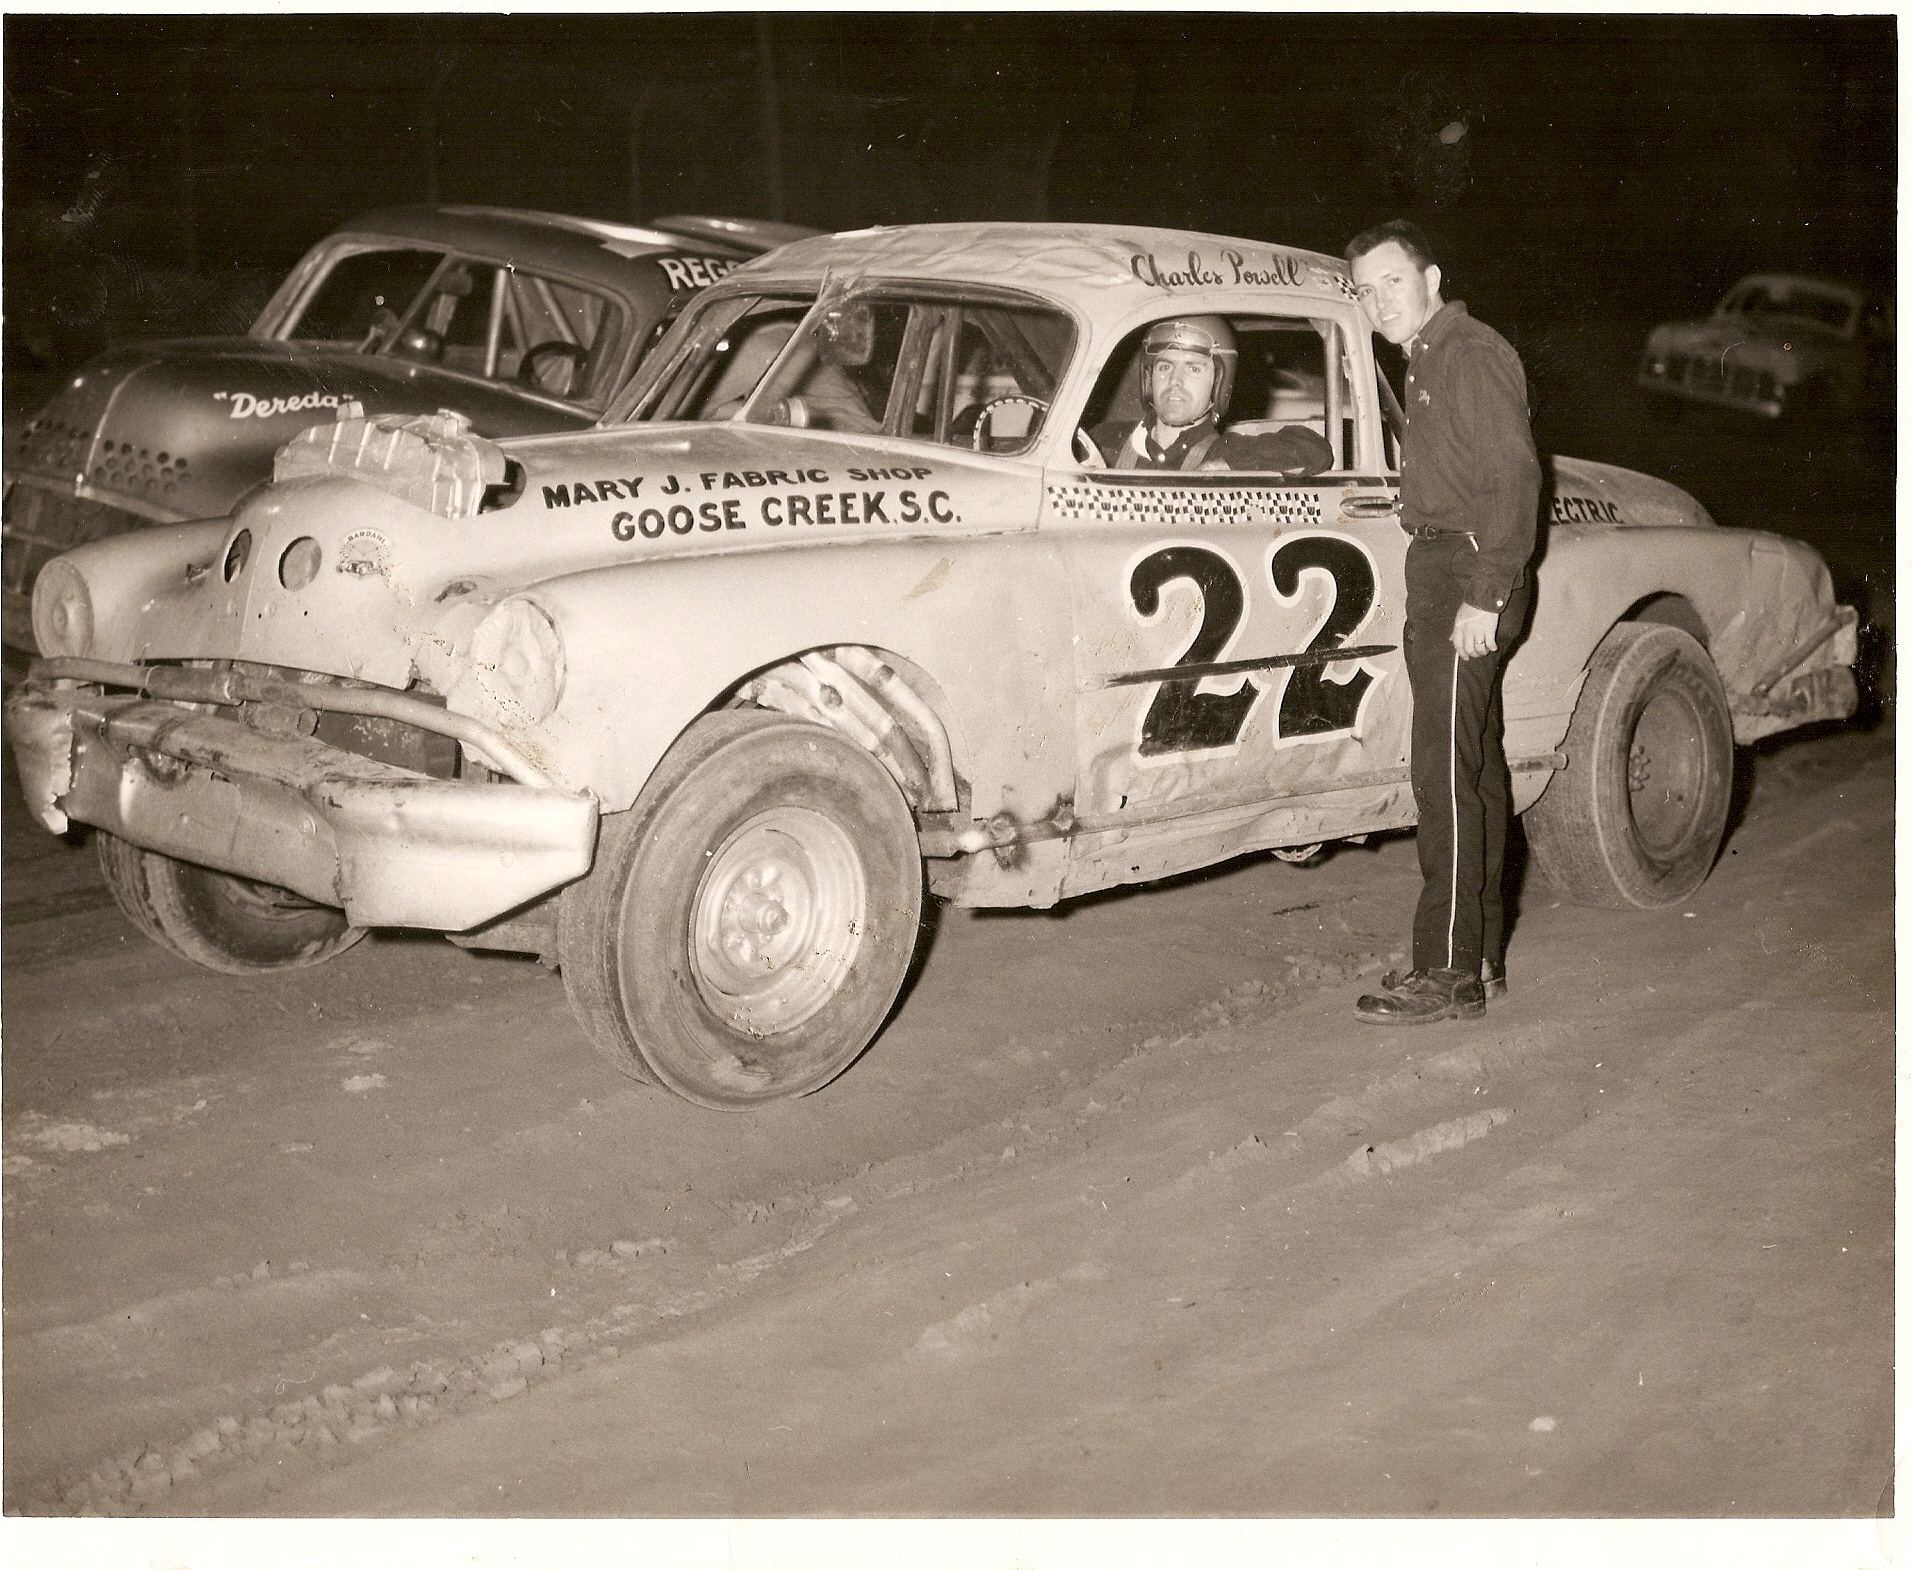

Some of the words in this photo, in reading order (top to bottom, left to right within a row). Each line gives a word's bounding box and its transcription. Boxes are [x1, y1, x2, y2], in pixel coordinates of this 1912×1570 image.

[1130, 251, 1223, 287] Charles
[1220, 249, 1308, 287] Powell
[541, 475, 644, 509] MARY
[660, 474, 691, 496] J.
[700, 469, 830, 490] FABRIC
[847, 467, 932, 481] SHOP
[611, 500, 746, 541] GOOSE
[1128, 534, 1378, 760] 22
